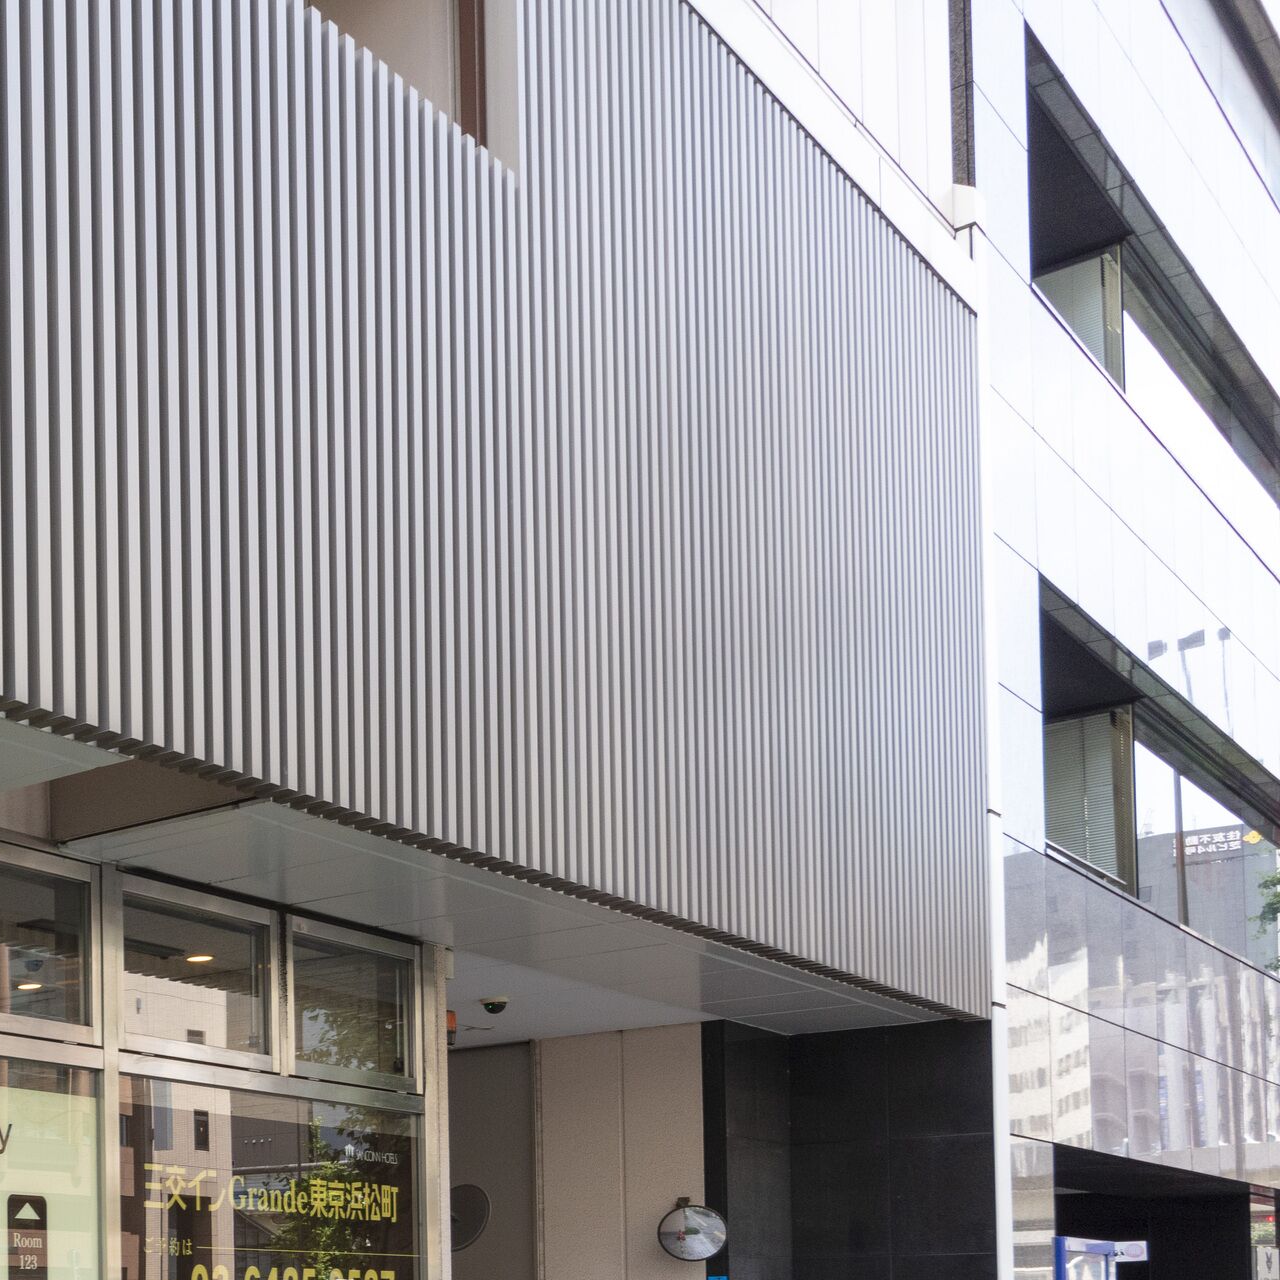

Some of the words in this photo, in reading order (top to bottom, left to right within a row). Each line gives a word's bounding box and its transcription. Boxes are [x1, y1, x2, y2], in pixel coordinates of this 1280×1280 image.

[144, 1163, 399, 1222] 三交インGrande東京浜松町
[13, 1232, 42, 1248] Room
[19, 1254, 38, 1270] 123
